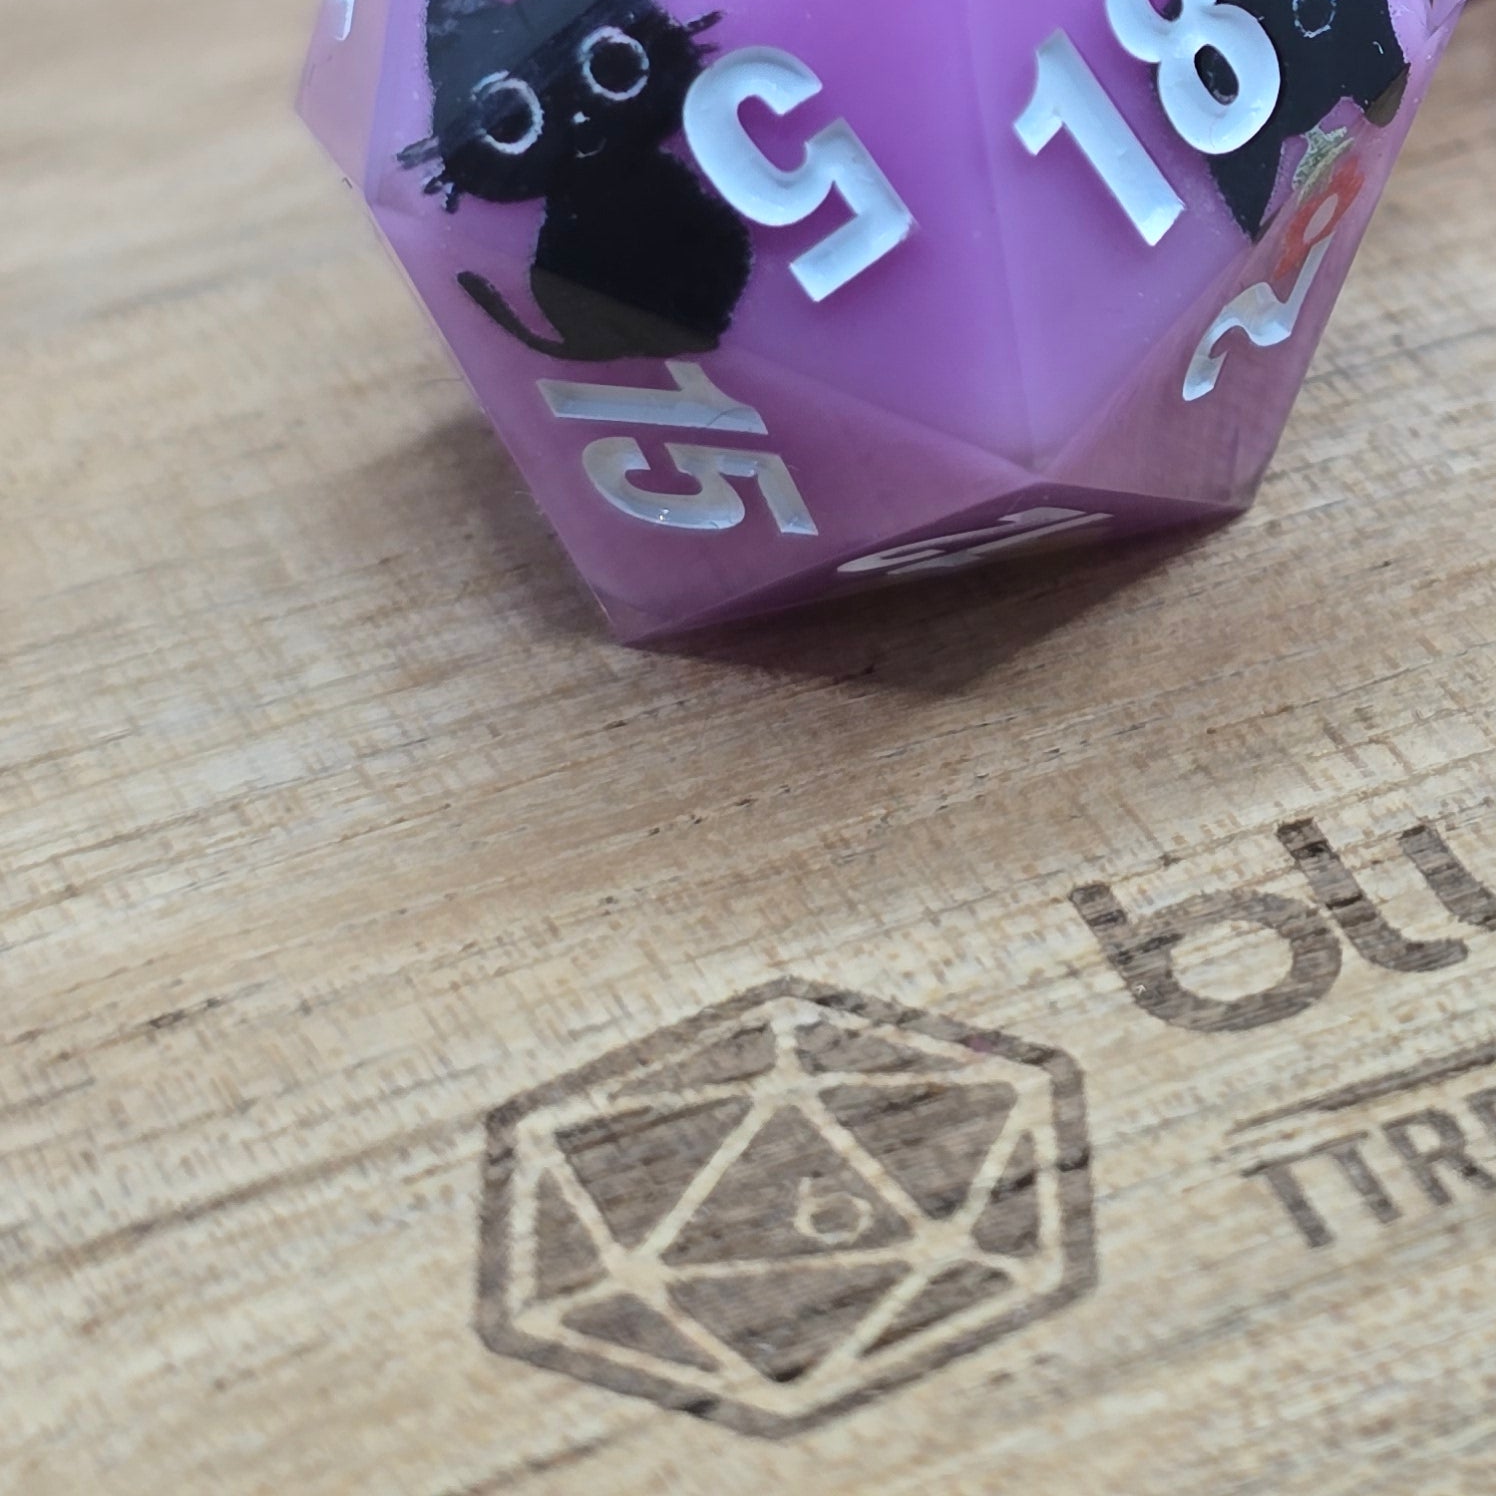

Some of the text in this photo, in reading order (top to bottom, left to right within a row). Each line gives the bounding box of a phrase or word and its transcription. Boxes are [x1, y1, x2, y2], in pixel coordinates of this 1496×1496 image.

[682, 47, 914, 303] 5
[1183, 232, 1335, 401] 2
[537, 360, 819, 537] 15
